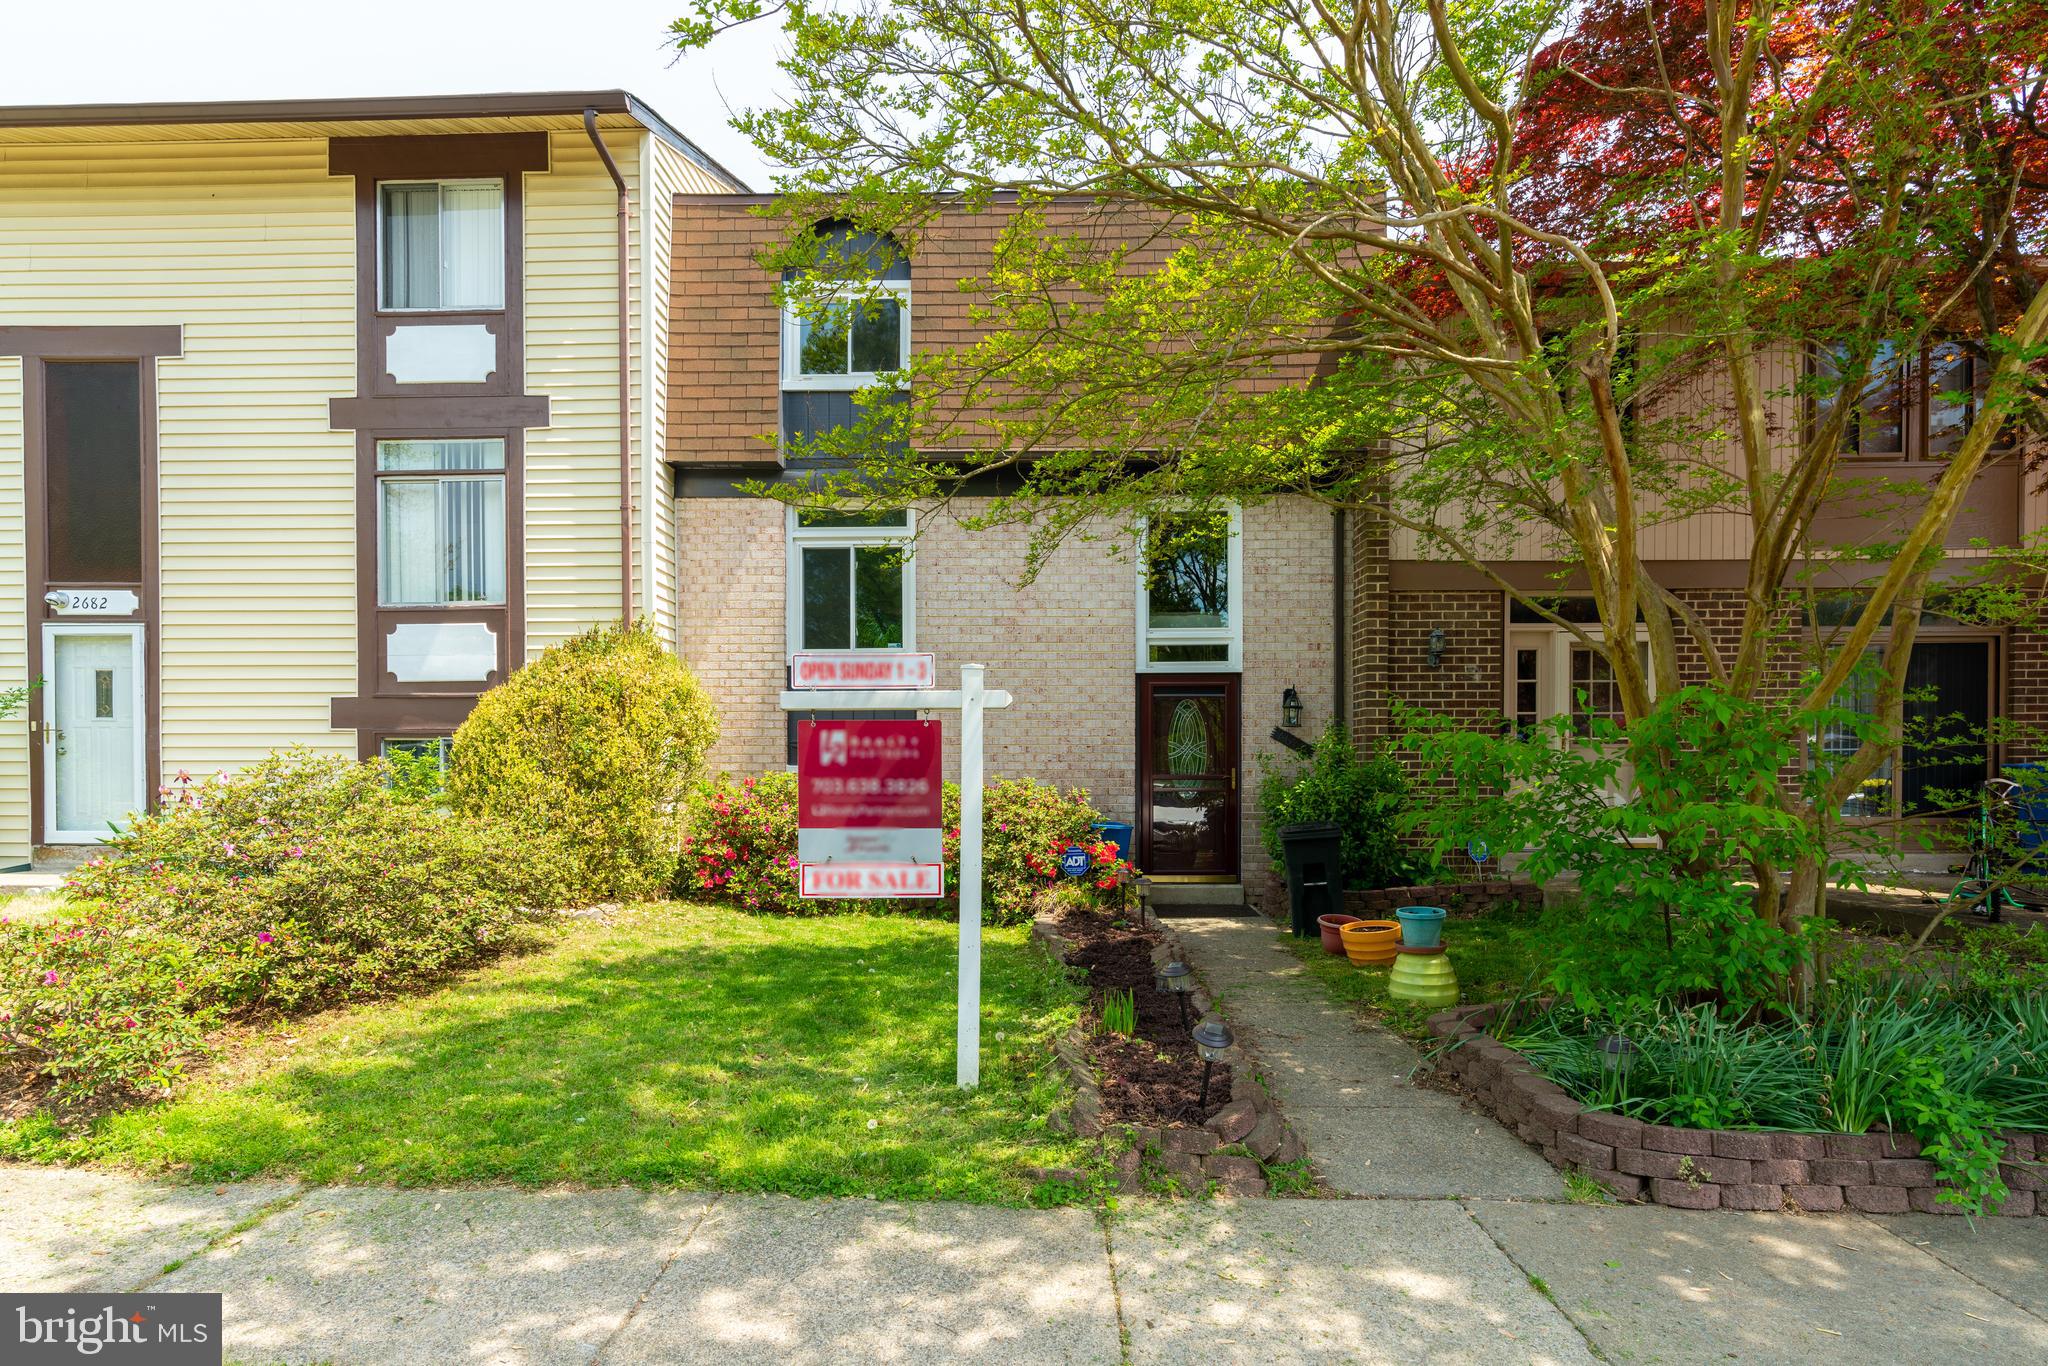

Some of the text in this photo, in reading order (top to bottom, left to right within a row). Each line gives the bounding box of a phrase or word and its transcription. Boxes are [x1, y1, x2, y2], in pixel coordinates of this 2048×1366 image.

[72, 596, 108, 609] 2682
[1065, 856, 1085, 867] ADT
[812, 871, 931, 890] FOR SALE
